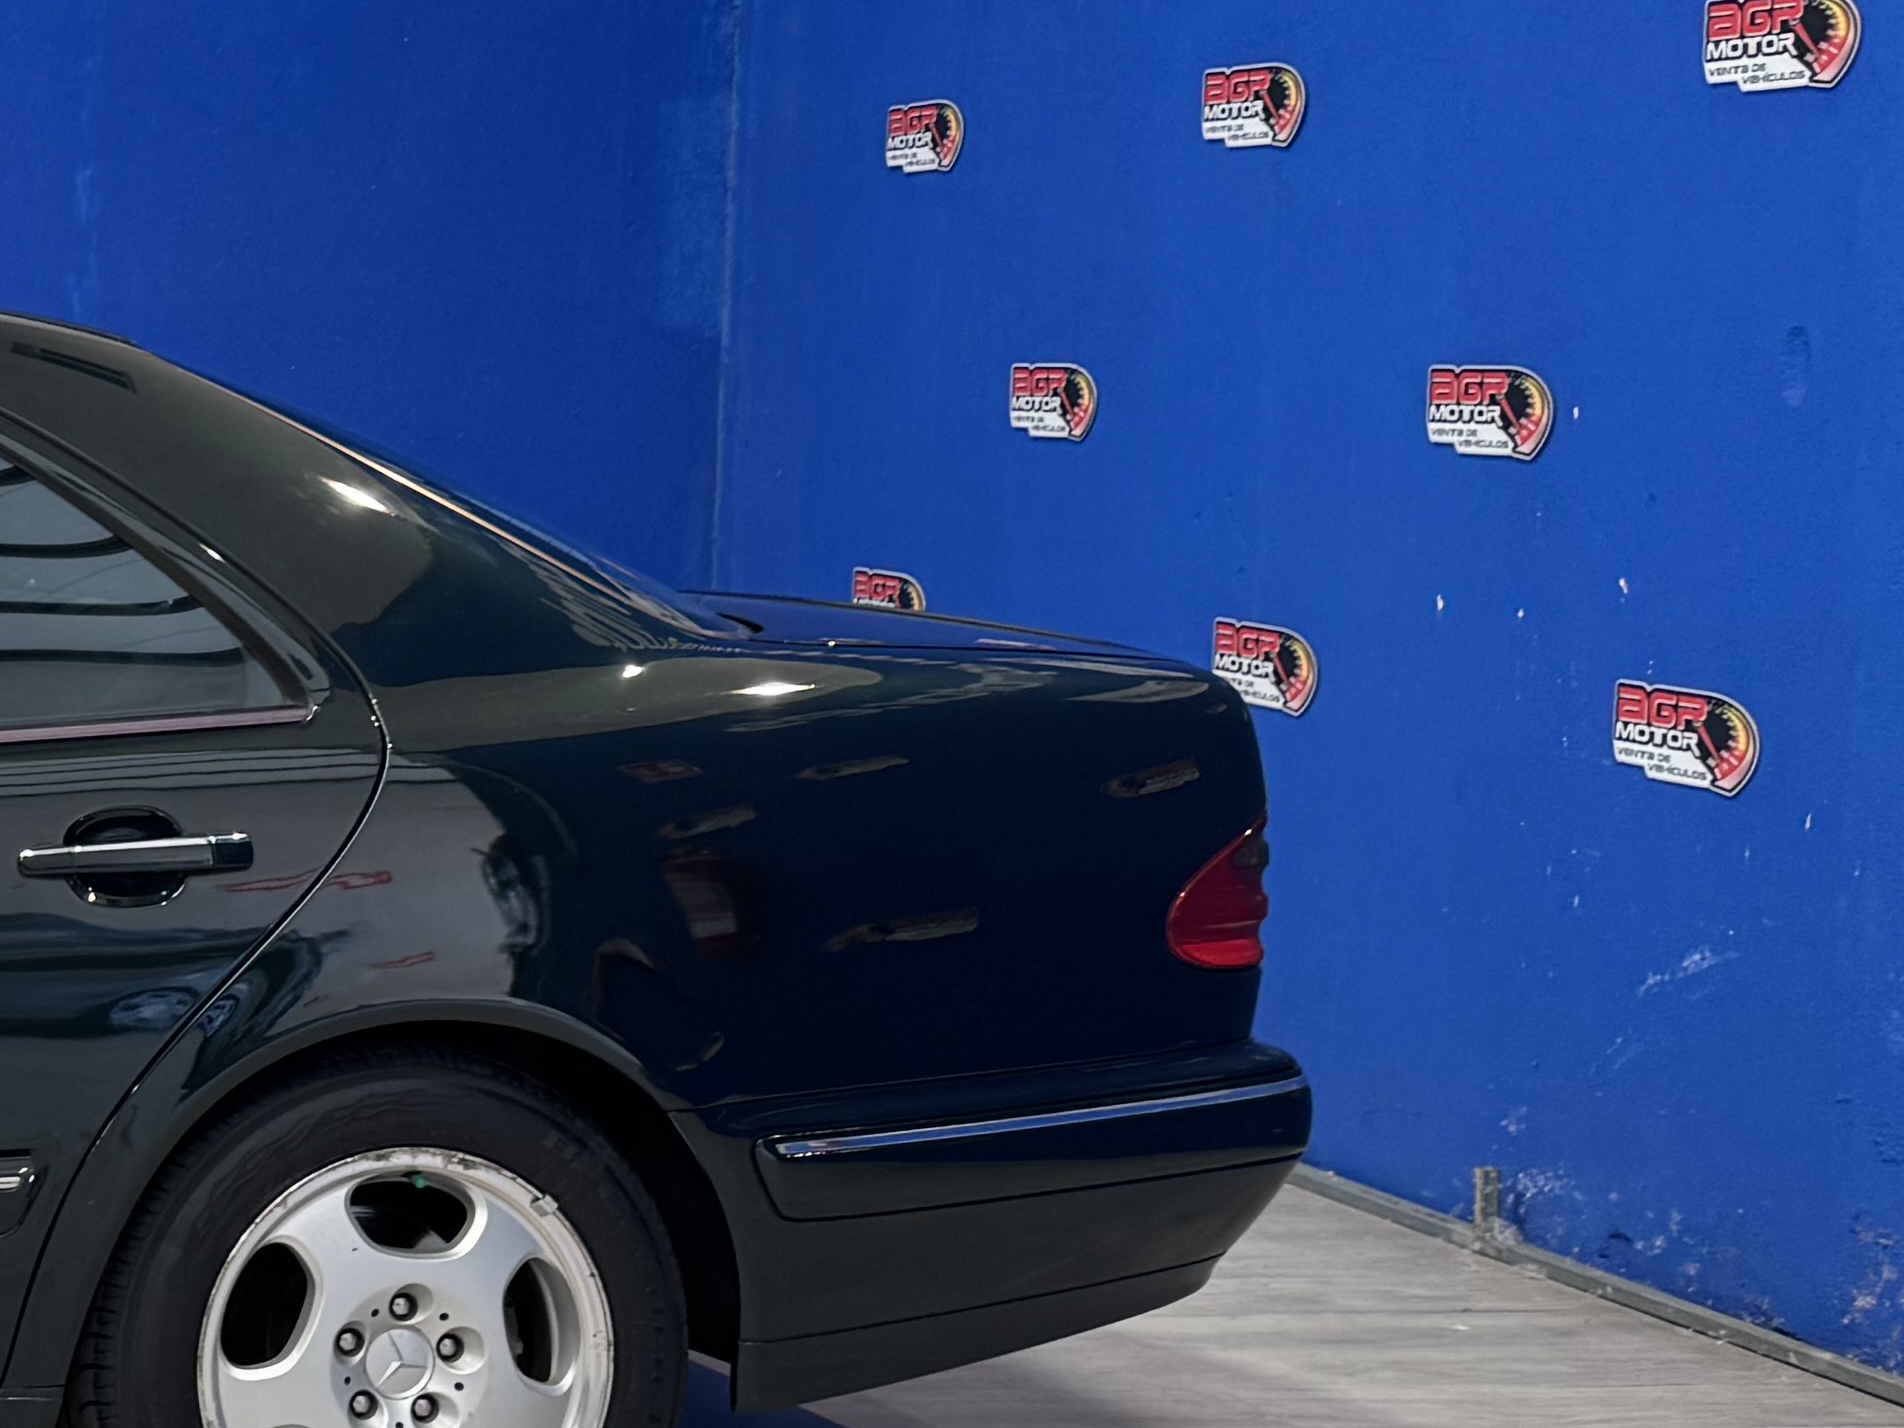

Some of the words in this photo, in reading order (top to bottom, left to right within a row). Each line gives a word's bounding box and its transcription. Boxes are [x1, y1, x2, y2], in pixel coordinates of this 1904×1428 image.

[1706, 32, 1798, 59] MOTOR
[1204, 100, 1265, 121] MOTOR
[1012, 396, 1062, 415] MOTOR
[1429, 404, 1503, 427] MOTOR
[1214, 653, 1275, 683] MOTOR
[1615, 721, 1701, 757] MOTOR
